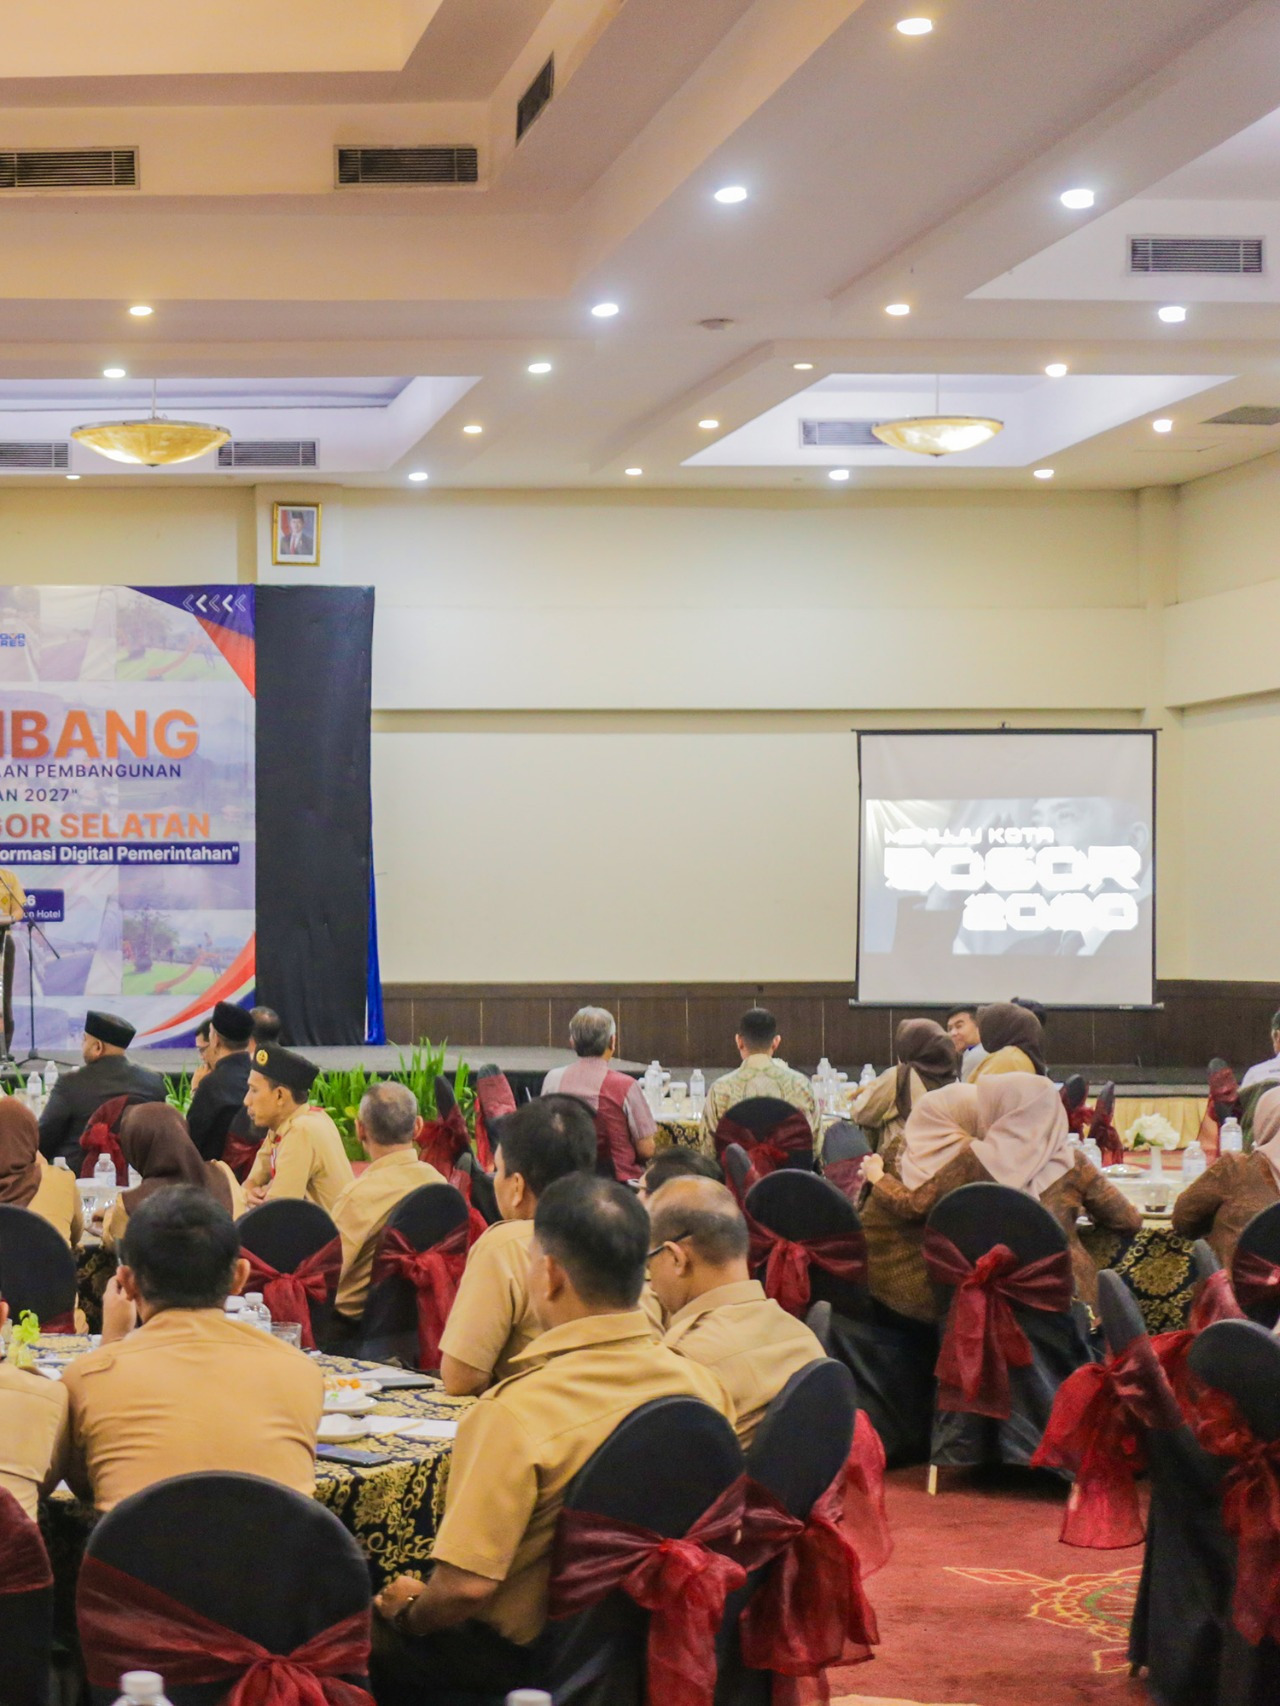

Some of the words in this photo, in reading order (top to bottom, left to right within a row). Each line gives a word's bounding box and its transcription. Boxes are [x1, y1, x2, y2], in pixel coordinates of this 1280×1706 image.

[35, 764, 182, 778] PEMBANGUNAN
[60, 812, 210, 839] SELATAN
[60, 845, 113, 864] Digital
[36, 909, 61, 918] Hotel
